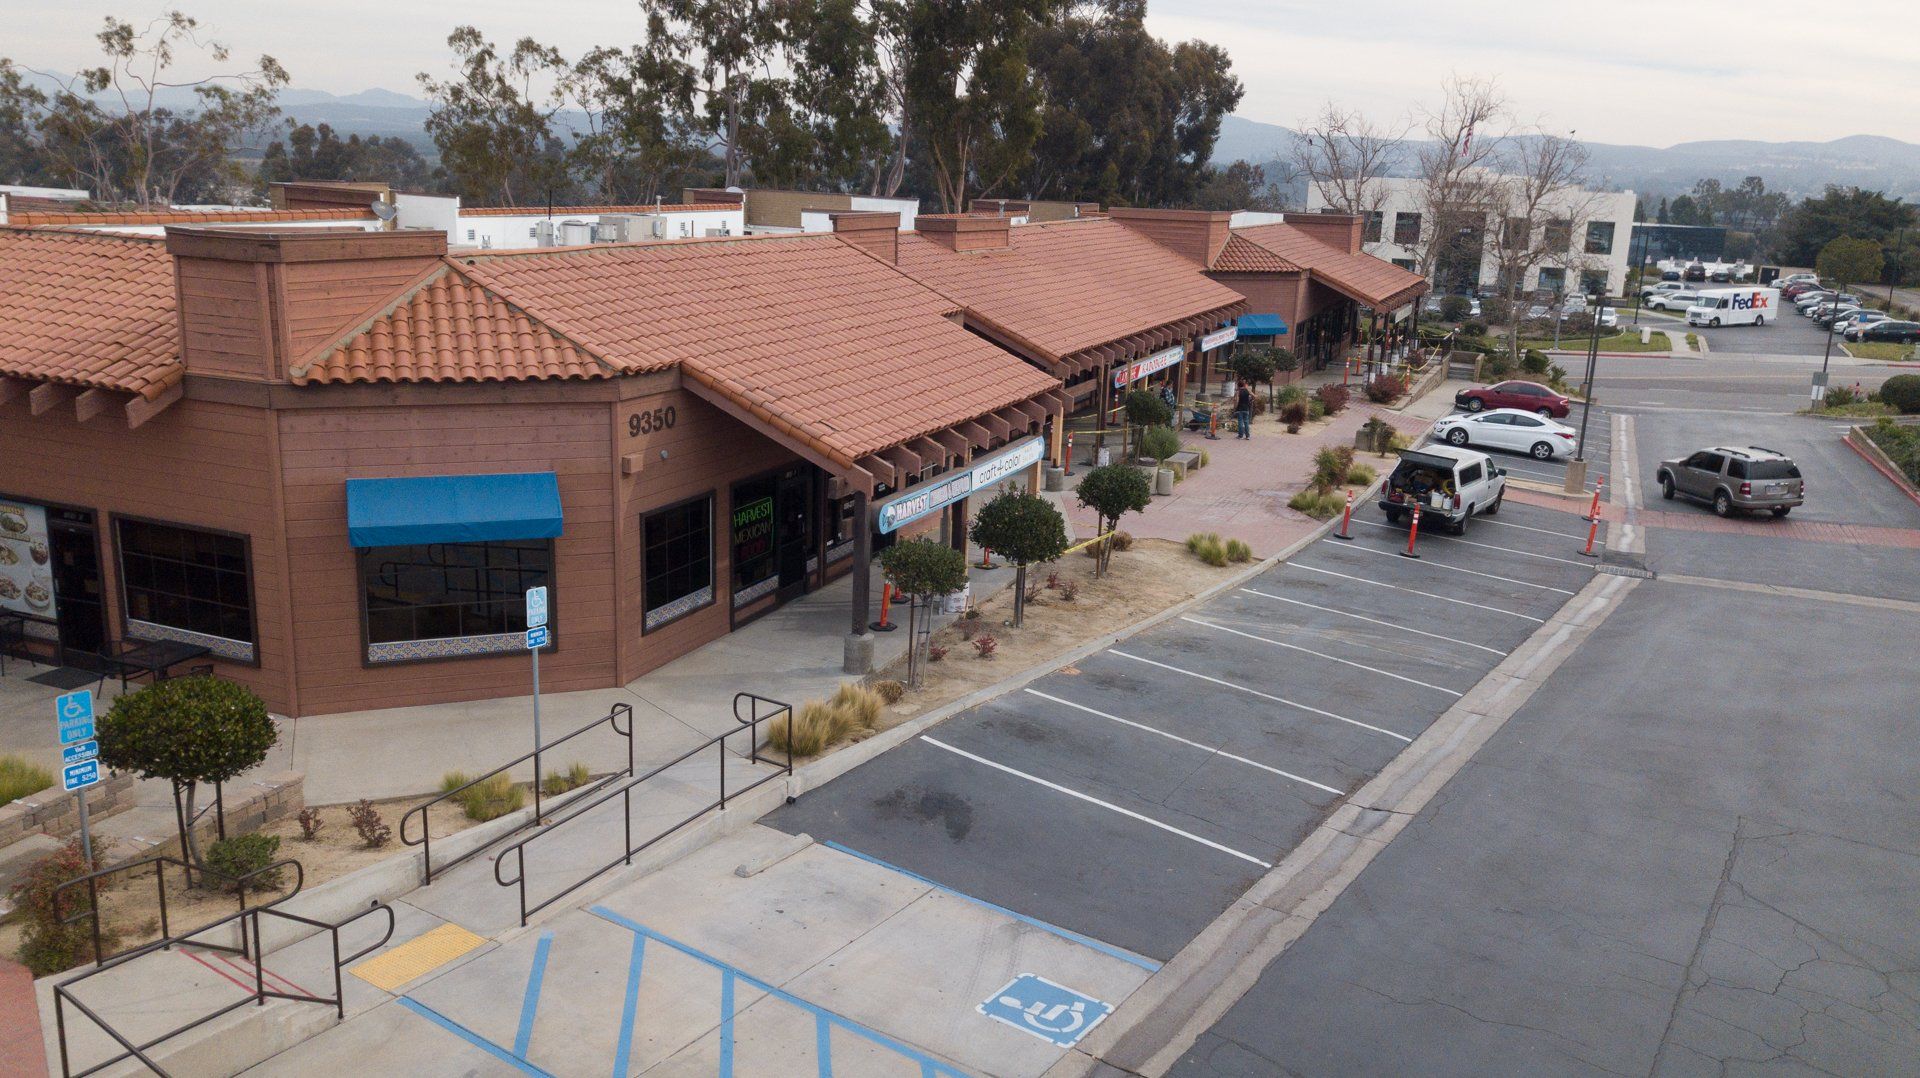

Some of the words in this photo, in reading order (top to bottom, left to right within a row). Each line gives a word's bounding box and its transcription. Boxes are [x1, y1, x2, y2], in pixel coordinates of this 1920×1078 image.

[1732, 292, 1768, 310] FedEx
[629, 406, 676, 437] 9350
[979, 465, 997, 484] craft
[1004, 454, 1021, 472] color
[734, 502, 771, 527] HARVEST
[895, 493, 928, 522] HARVEST
[734, 521, 772, 545] MEXICAN
[60, 715, 92, 728] PARKING
[67, 727, 87, 739] ONLY
[65, 749, 97, 762] ACCESSIBLE
[66, 777, 78, 786] FINE
[81, 772, 97, 782] $250
[69, 765, 92, 777] MINIMUM
